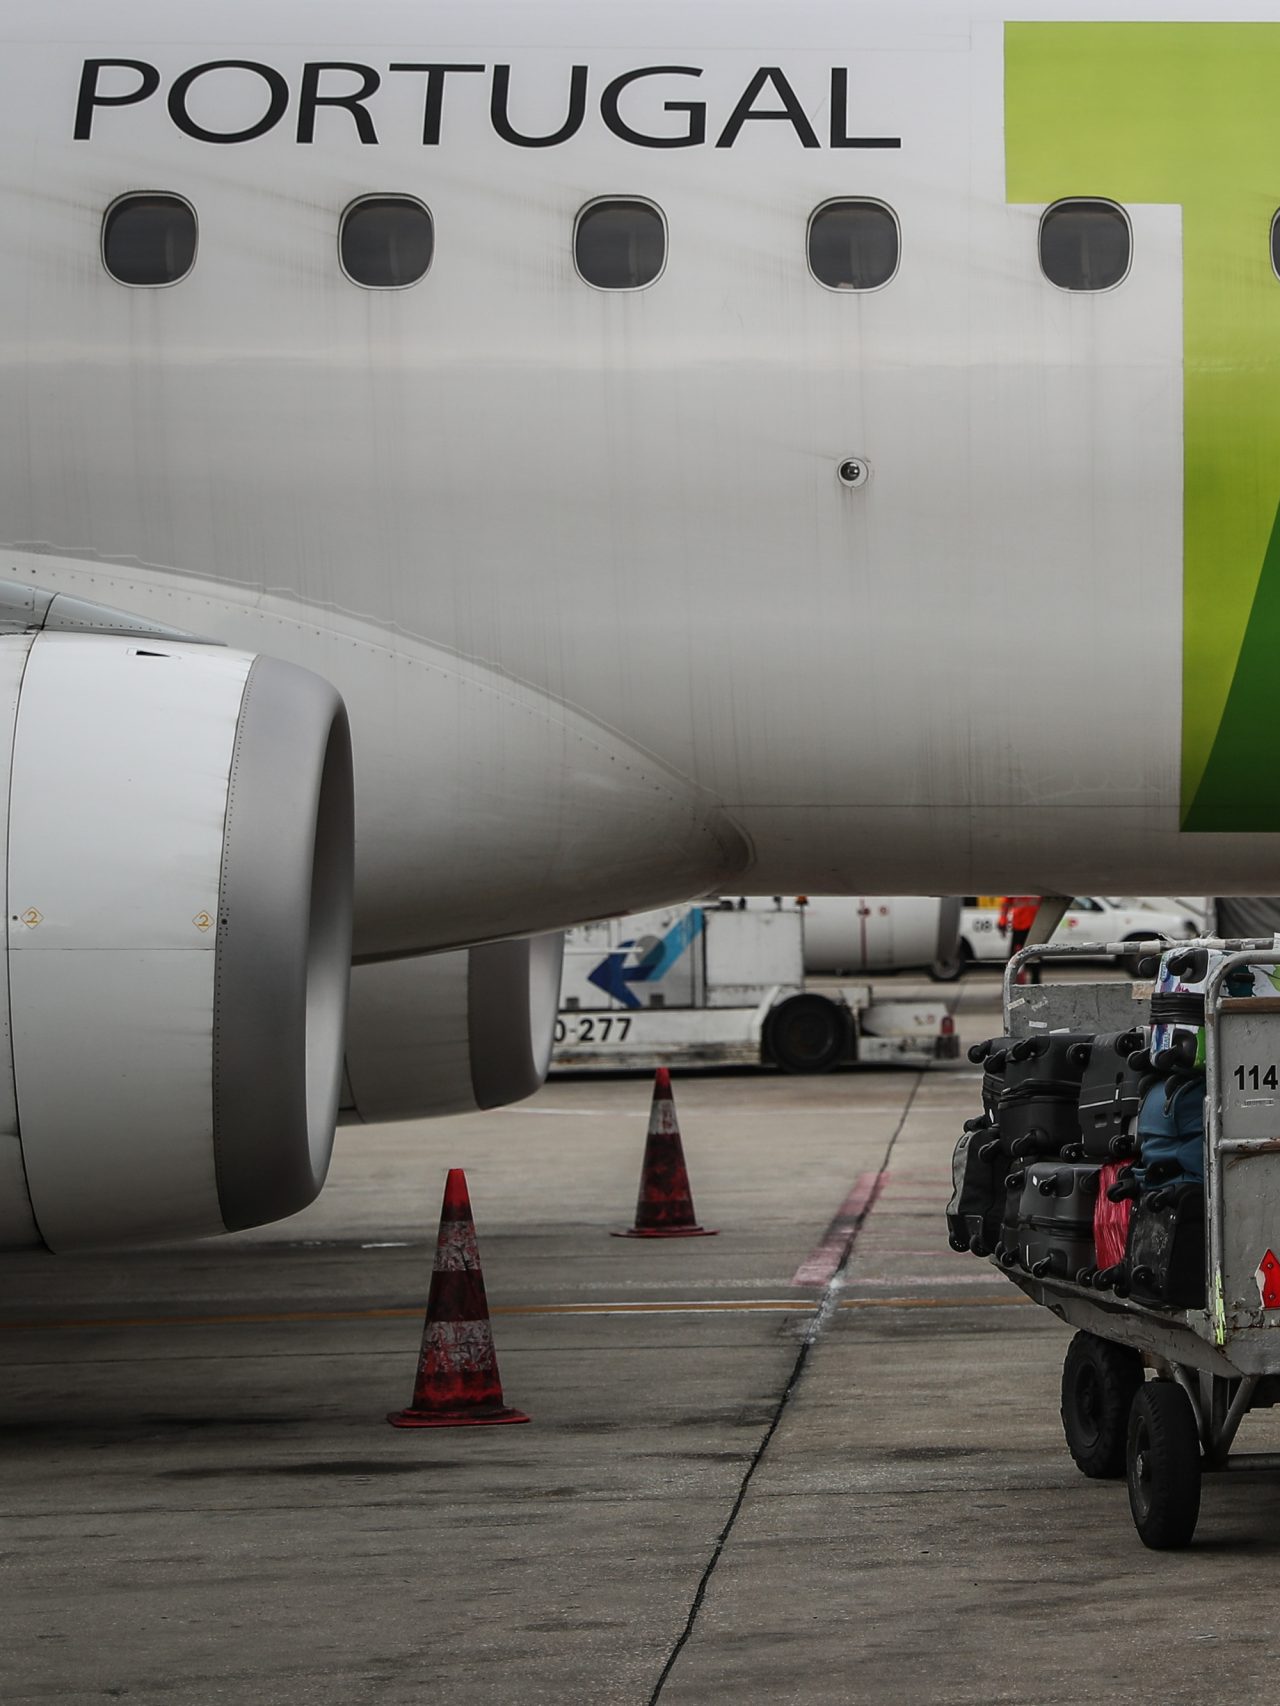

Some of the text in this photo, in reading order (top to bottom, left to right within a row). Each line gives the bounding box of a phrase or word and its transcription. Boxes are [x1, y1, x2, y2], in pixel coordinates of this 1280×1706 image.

[73, 59, 901, 150] PORTUGAL
[26, 911, 38, 923] 2
[198, 914, 209, 927] 2
[1233, 1064, 1279, 1091] 114
